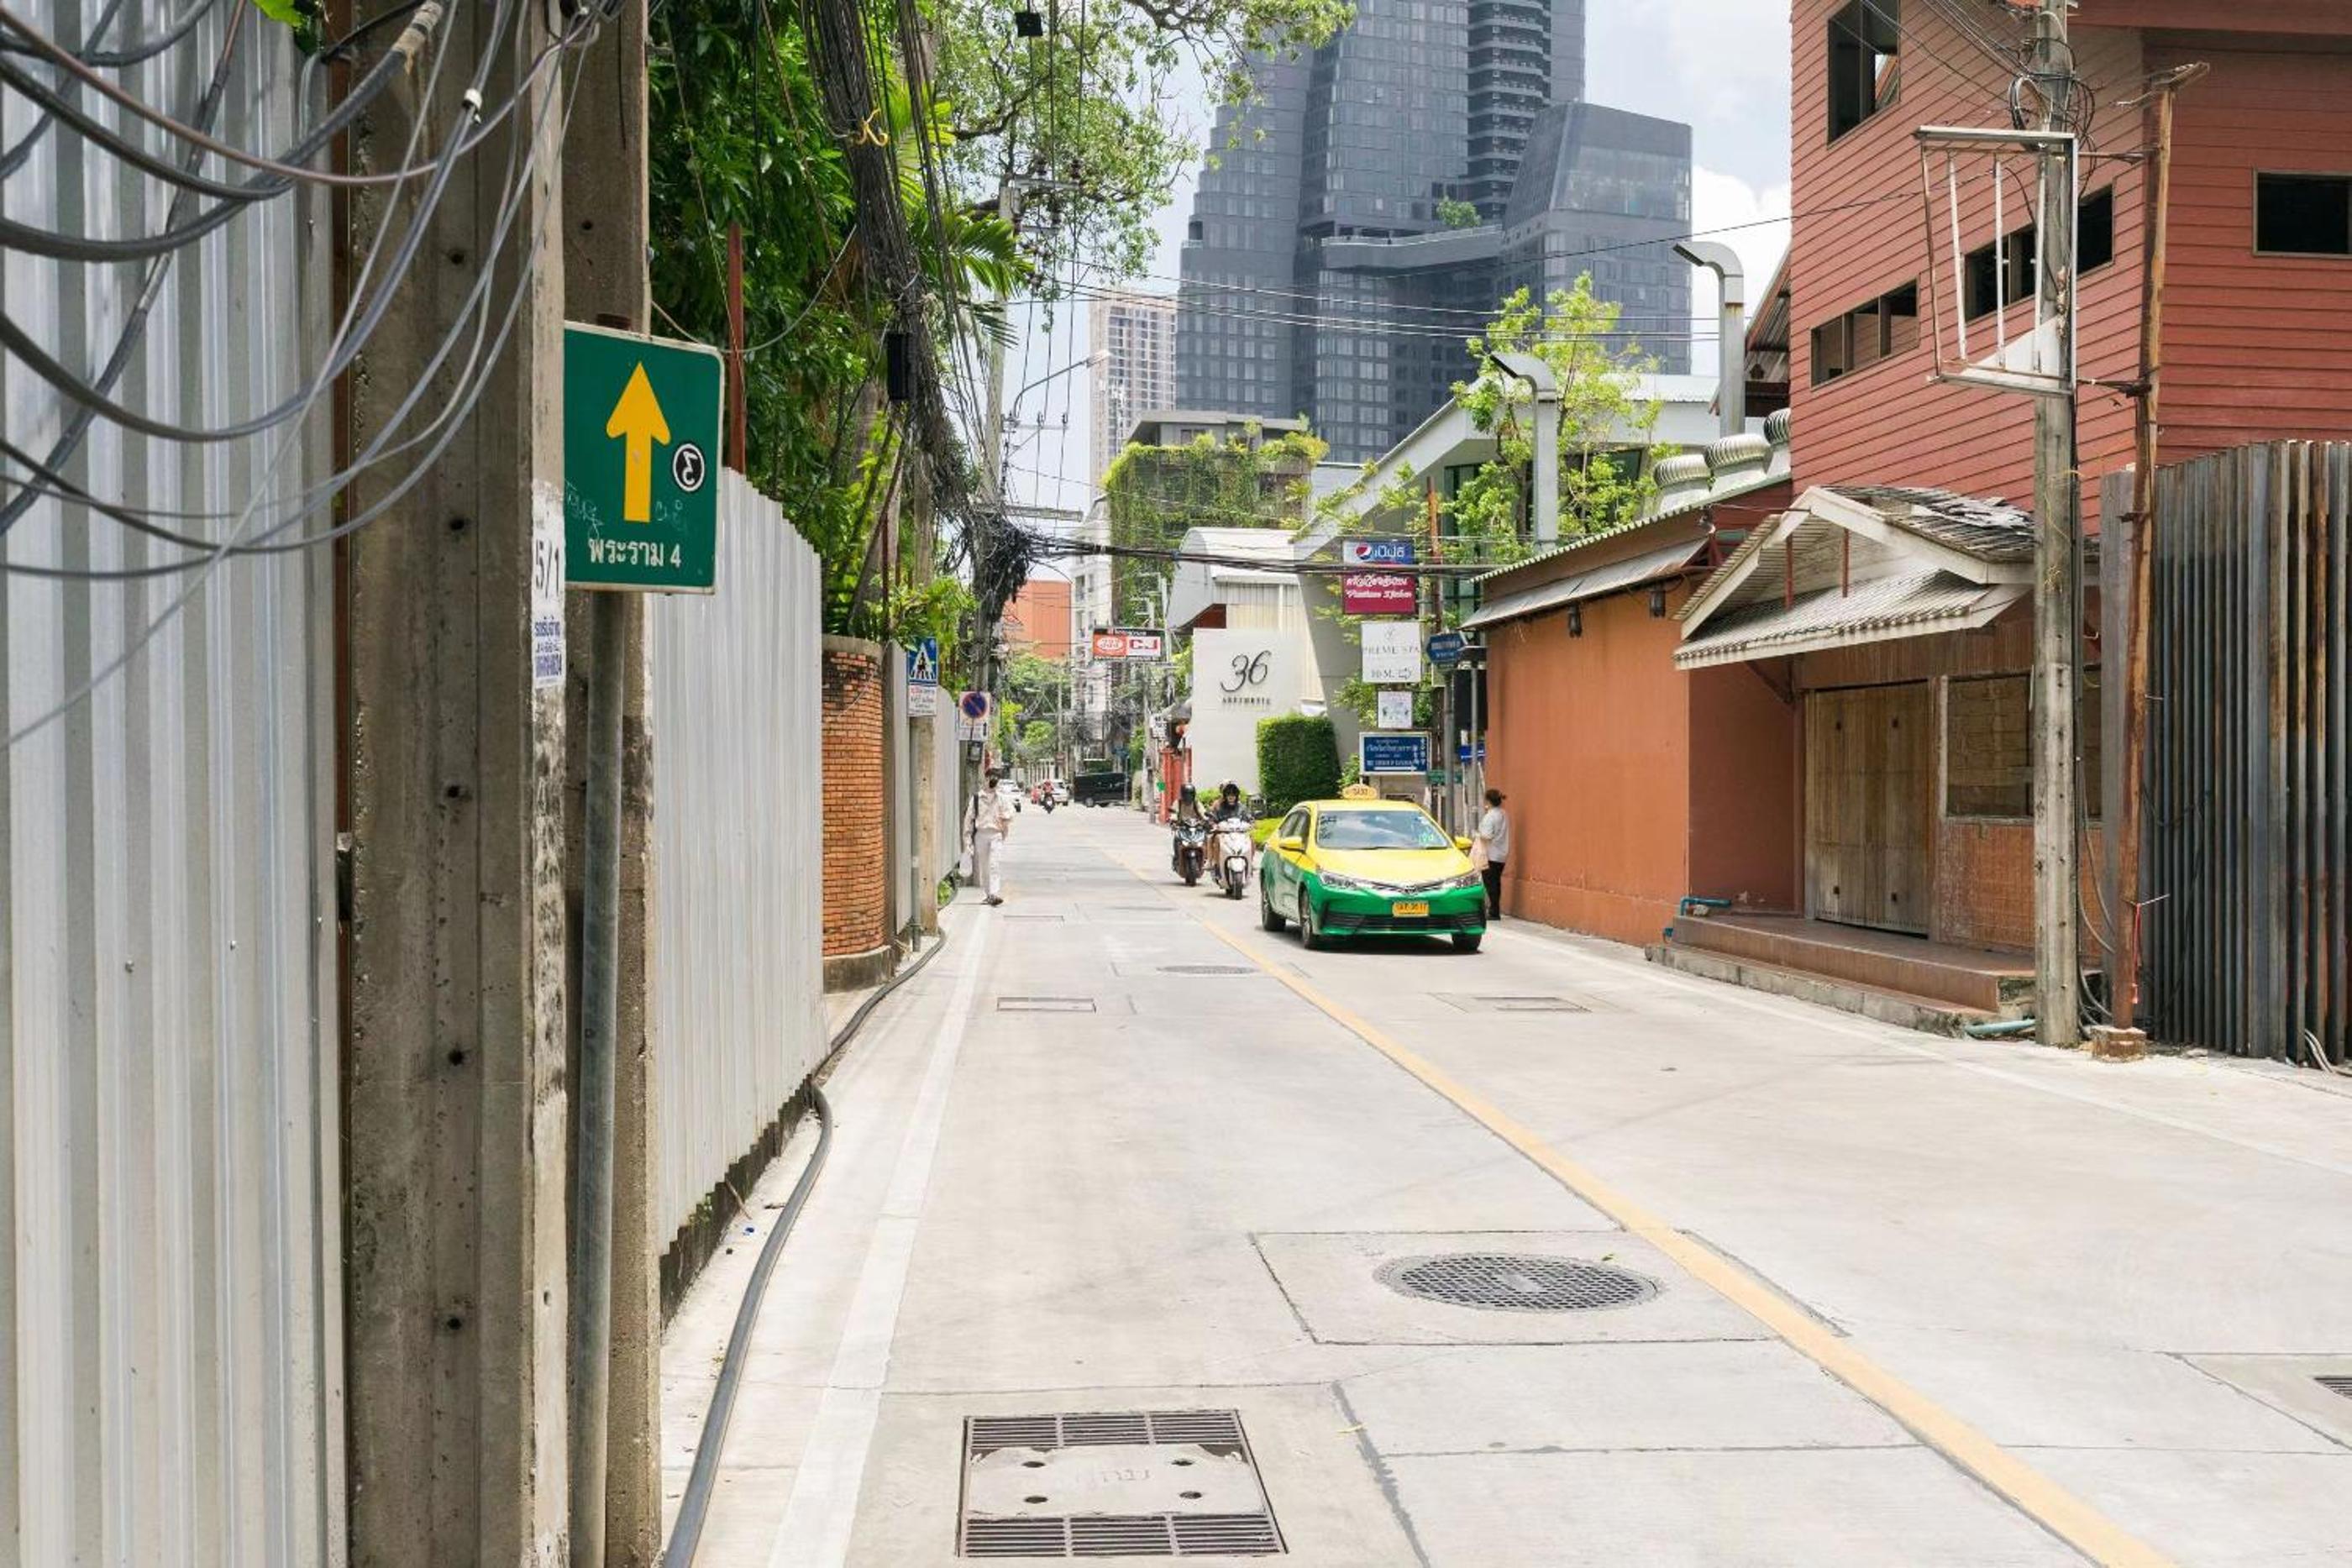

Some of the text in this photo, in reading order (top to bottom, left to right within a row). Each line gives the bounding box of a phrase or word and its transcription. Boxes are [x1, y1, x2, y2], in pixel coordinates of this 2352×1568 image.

[588, 538, 682, 568] พระราม 4
[1220, 649, 1273, 693] 36
